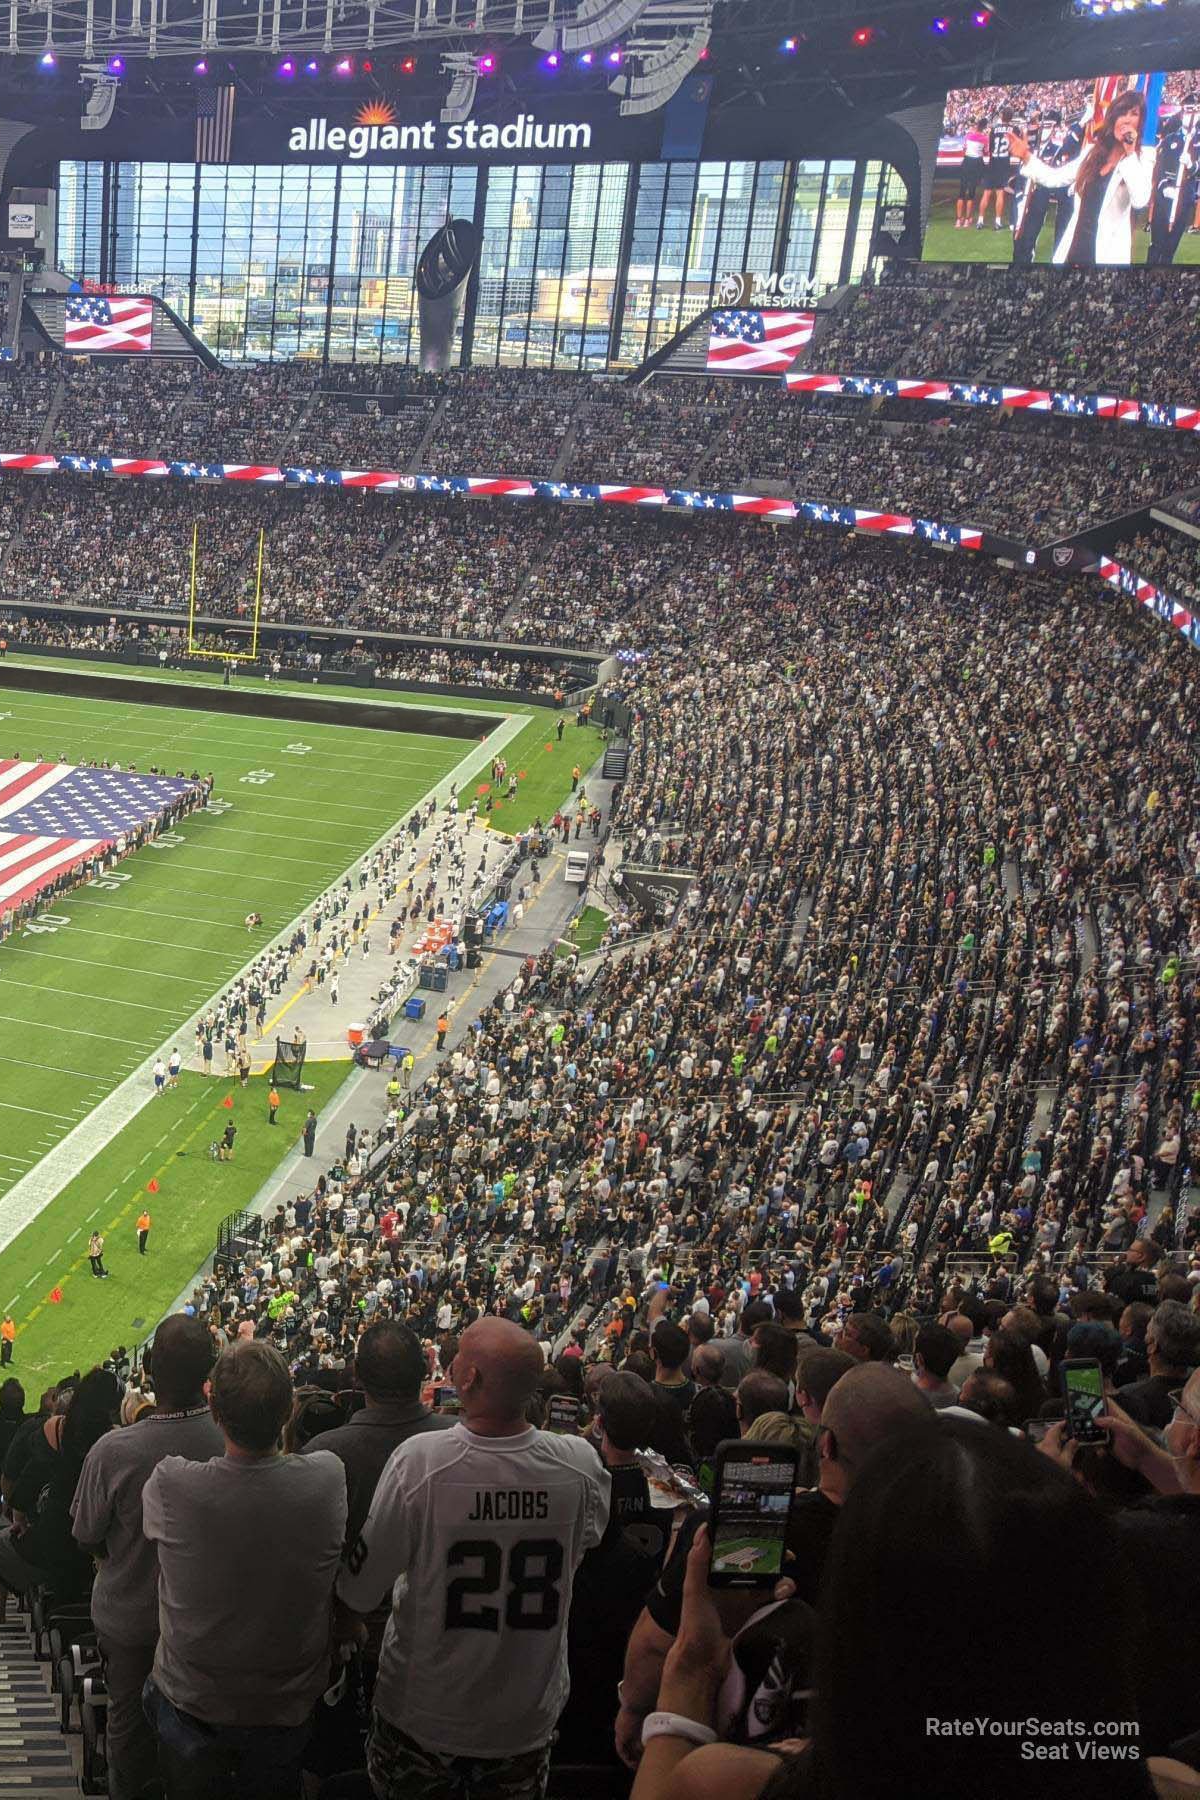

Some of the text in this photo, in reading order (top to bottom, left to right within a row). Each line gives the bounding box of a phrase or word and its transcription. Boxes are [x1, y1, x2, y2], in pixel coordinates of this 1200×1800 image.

[288, 113, 592, 159] allegiant stadium
[991, 137, 1010, 158] 12
[120, 283, 153, 295] LIGHT
[753, 271, 820, 295] MGM
[751, 295, 818, 308] RESORTS
[400, 476, 415, 489] 40
[281, 744, 312, 755] 10
[239, 770, 275, 785] 20
[87, 870, 133, 890] 50
[25, 913, 72, 934] 40
[468, 1490, 549, 1521] JACOBS
[445, 1539, 564, 1633] 28
